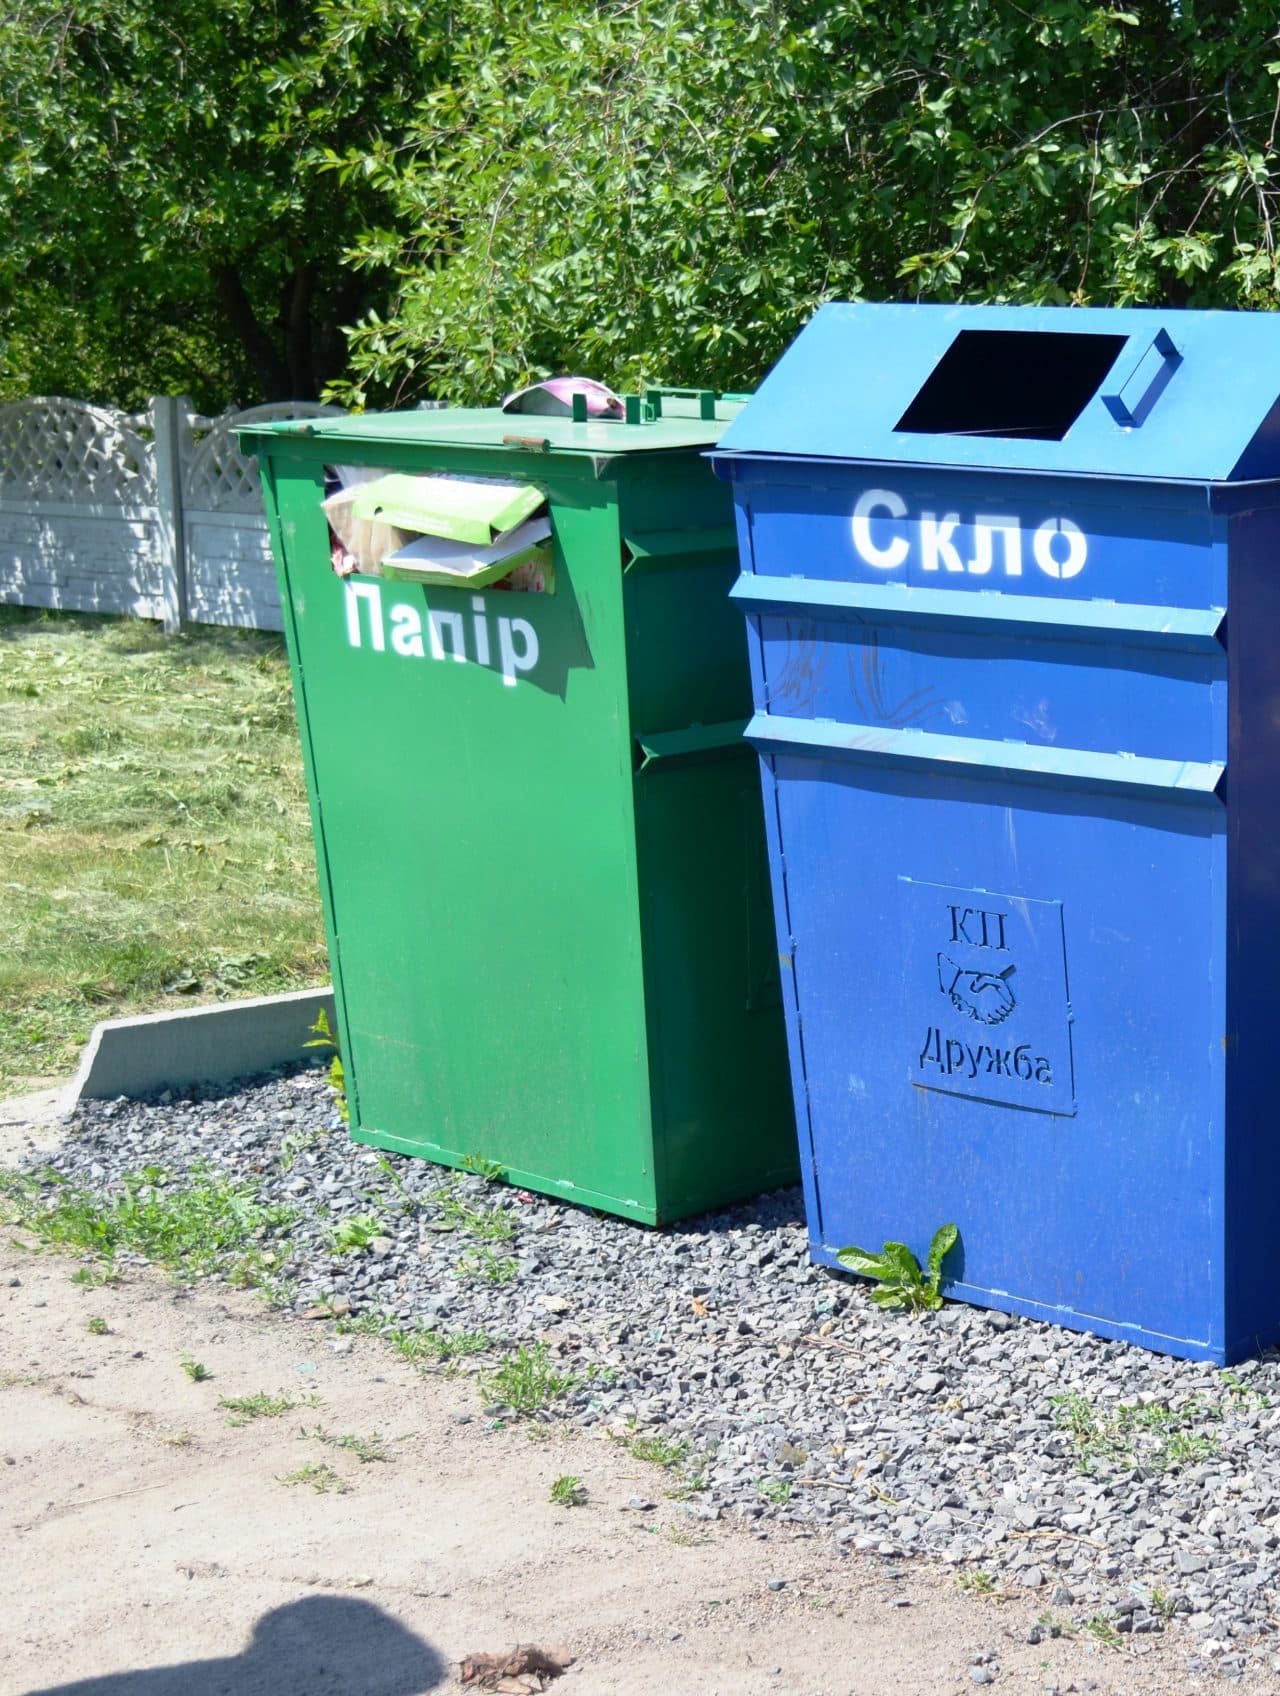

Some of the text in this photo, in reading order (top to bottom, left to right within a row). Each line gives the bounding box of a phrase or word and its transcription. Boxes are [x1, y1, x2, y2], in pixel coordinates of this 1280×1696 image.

[852, 489, 1087, 579] Скло
[344, 582, 540, 687] Папір
[947, 905, 1010, 951] КП
[919, 1027, 1055, 1086] Дружба
